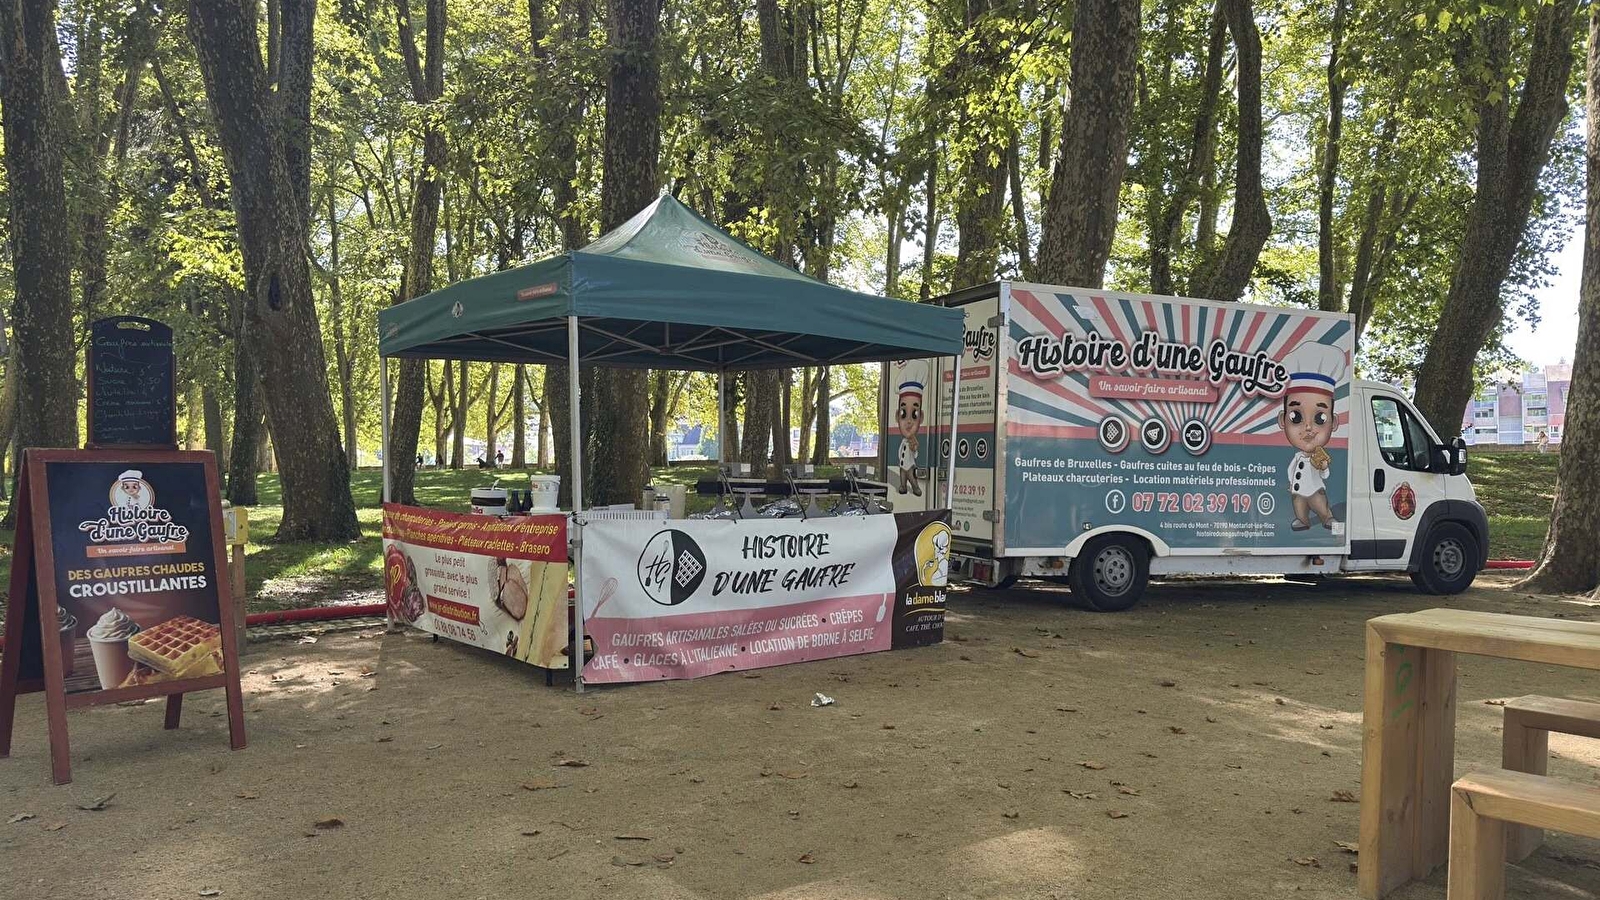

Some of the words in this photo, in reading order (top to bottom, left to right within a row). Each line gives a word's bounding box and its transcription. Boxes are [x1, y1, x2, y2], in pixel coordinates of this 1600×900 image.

[1018, 333, 1127, 374] Histoire
[1132, 332, 1205, 371] d'une
[1209, 340, 1289, 393] Gaufre
[1098, 380, 1112, 391] Un
[1167, 384, 1208, 396] artisanal
[1014, 457, 1052, 468] Gaufres
[1053, 458, 1065, 469] de
[1067, 458, 1112, 470] Bruxelles
[1120, 459, 1154, 470] Gaufres
[1156, 460, 1183, 471] cuites
[1184, 463, 1195, 471] au
[1196, 461, 1210, 472] feu
[1211, 462, 1222, 472] de
[1223, 462, 1241, 473] bois
[1247, 462, 1276, 475] Crêpes
[1022, 471, 1064, 483] Plateaux
[1065, 472, 1123, 484] charcuteries
[1133, 474, 1171, 485] Location
[1172, 474, 1214, 486] matériels
[1215, 476, 1276, 488] professionnels
[978, 486, 986, 496] 19
[1132, 492, 1154, 513] 07
[1157, 492, 1180, 513] 72
[1182, 492, 1204, 513] 02
[1206, 492, 1228, 513] 39
[1231, 492, 1251, 513] 19
[109, 505, 170, 525] Histoire
[80, 519, 135, 542] d'une
[138, 521, 189, 543] Gaufre
[519, 541, 550, 555] Brasero
[741, 532, 830, 559] HISTOIRE
[434, 552, 441, 564] Le
[441, 553, 452, 566] plus
[453, 557, 466, 568] petit
[68, 569, 91, 581] DES
[93, 566, 150, 580] GAUFRES
[152, 562, 205, 576] CHAUDES
[446, 571, 458, 582] avec
[458, 572, 465, 582] le
[465, 573, 479, 586] plus
[712, 568, 778, 597] D'UNE
[781, 562, 856, 592] GAUFRE
[69, 575, 207, 598] CROUSTILLANTES
[433, 583, 447, 594] grand
[448, 588, 468, 599] service
[612, 632, 664, 648] GAUFRES
[665, 625, 729, 645] ARTISANALES
[730, 619, 764, 638] SALÉES
[765, 618, 778, 632] OU
[779, 612, 819, 631] SUCRÉES
[829, 608, 863, 626] CRÊPES
[592, 651, 618, 670] CAFÉ
[633, 653, 678, 667] GLACES
[681, 647, 687, 665] À
[687, 643, 738, 664] L'ITALIENNE
[749, 636, 795, 655] LOCATION
[798, 635, 809, 649] DE
[812, 631, 840, 647] BORNE
[841, 628, 848, 643] À
[849, 627, 875, 643] SELFIE
